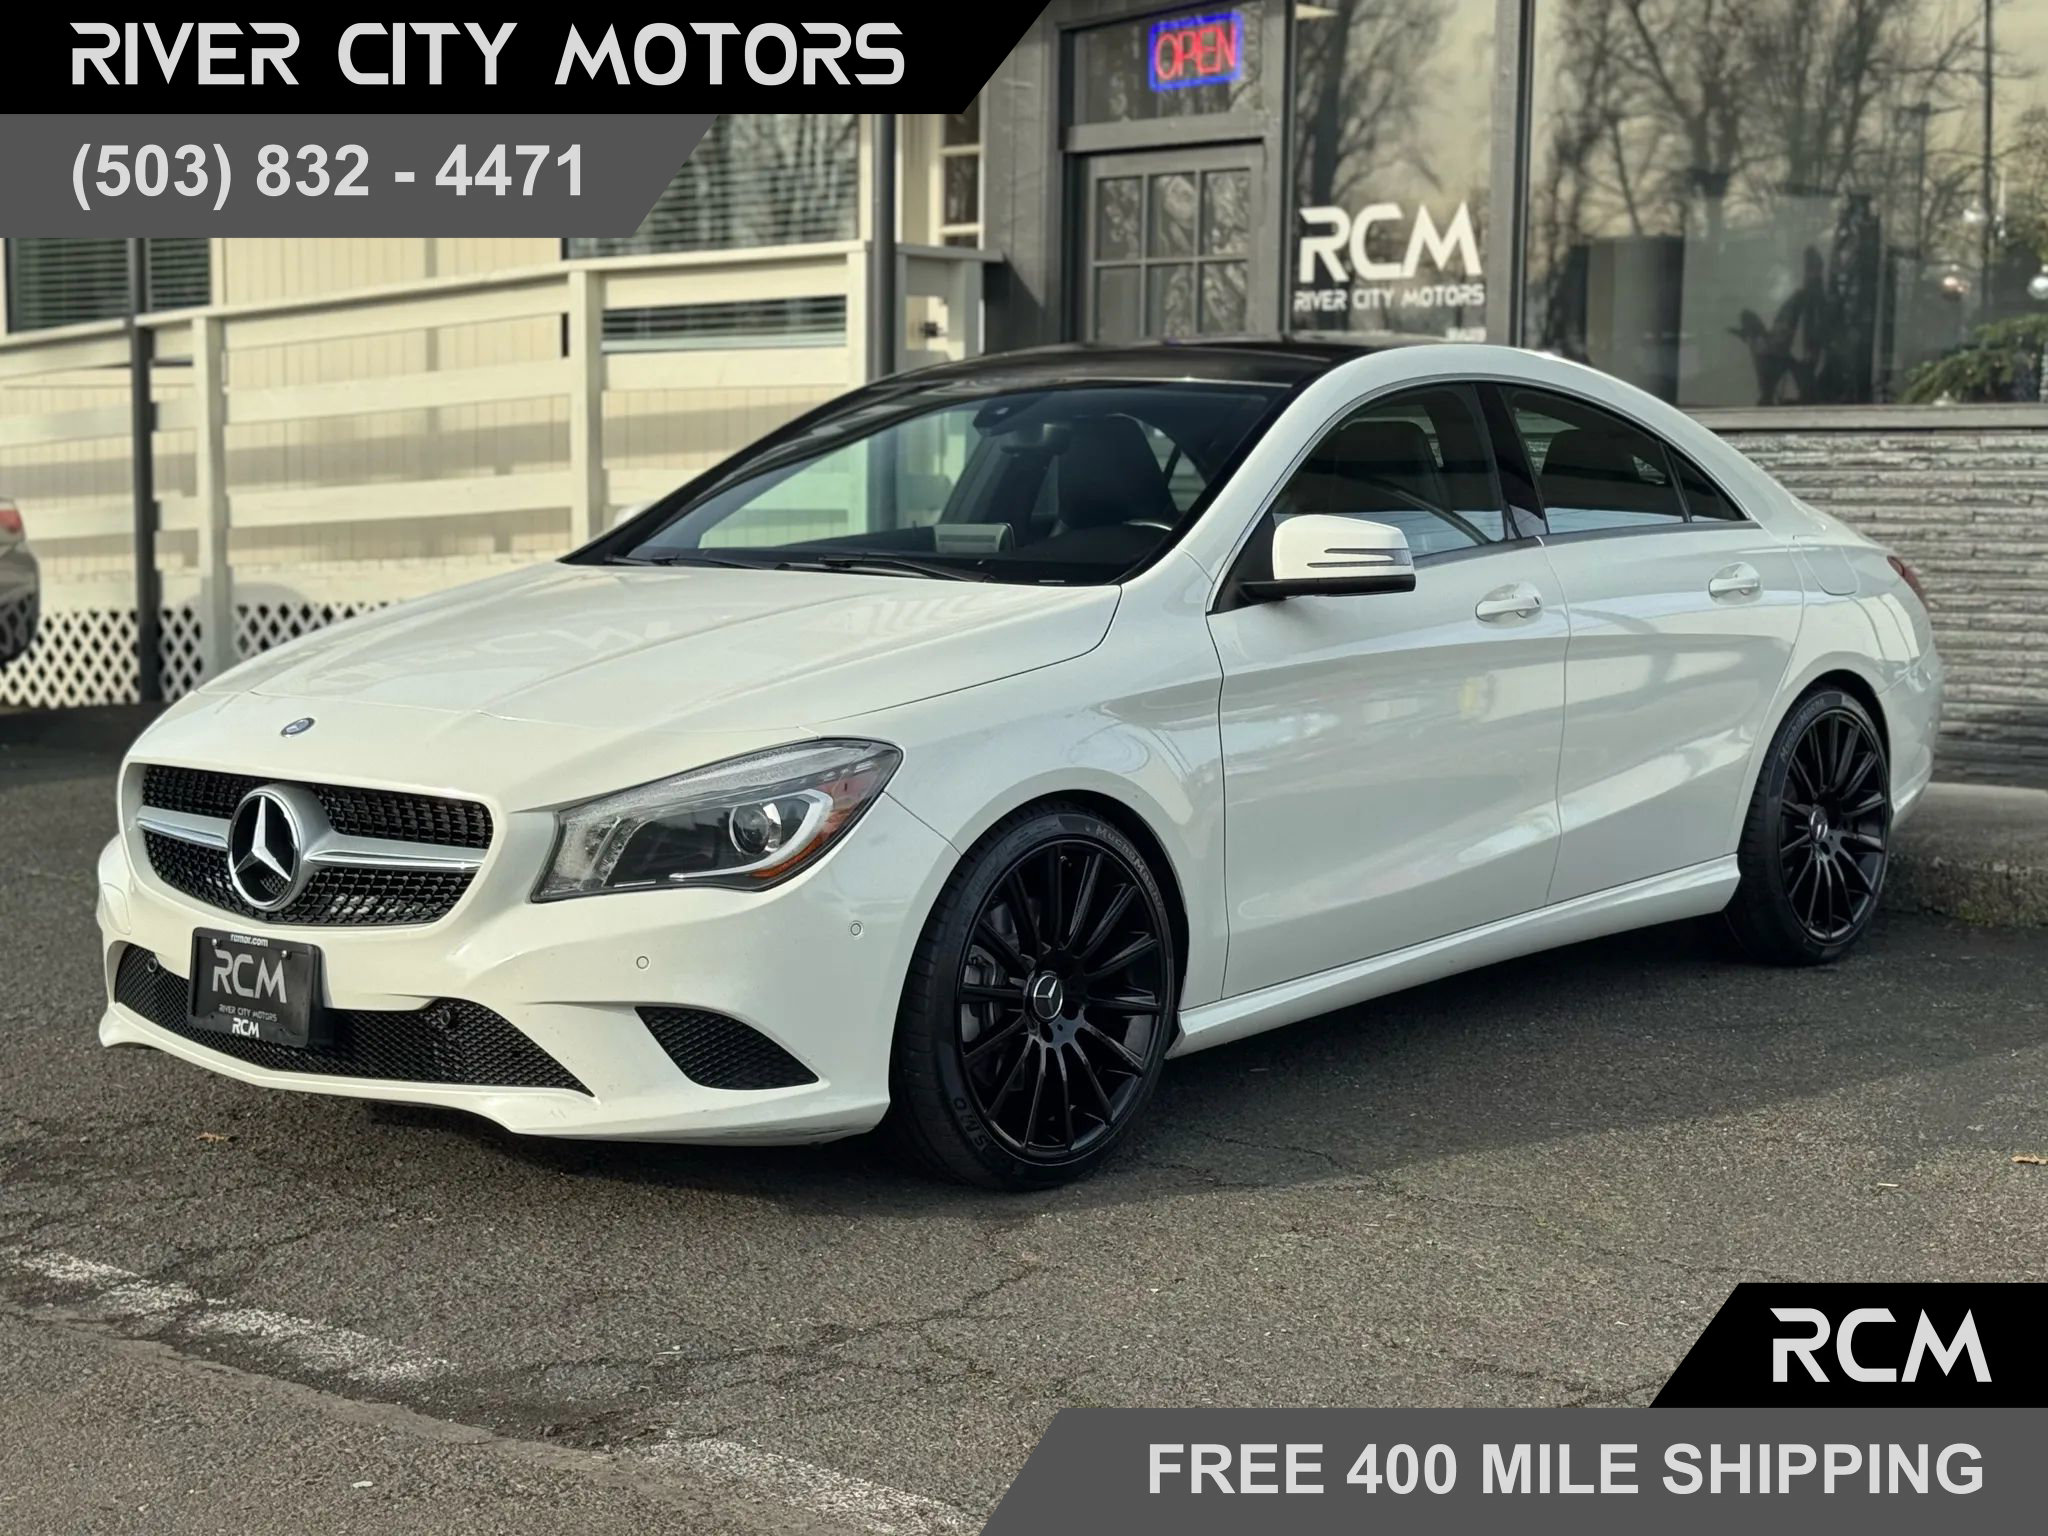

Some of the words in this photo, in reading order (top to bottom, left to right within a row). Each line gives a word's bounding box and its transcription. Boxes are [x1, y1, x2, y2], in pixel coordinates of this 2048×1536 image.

[1155, 23, 1236, 80] OPEN
[1299, 201, 1482, 283] RCM
[1294, 289, 1347, 312] RIVER
[1353, 288, 1394, 310] CITY
[1401, 283, 1485, 308] MOTORS
[212, 948, 287, 1004] RCM
[219, 1004, 236, 1015] RIVER
[237, 1007, 250, 1017] CITY
[252, 1010, 278, 1022] MOTORS
[232, 1017, 260, 1038] RCM
